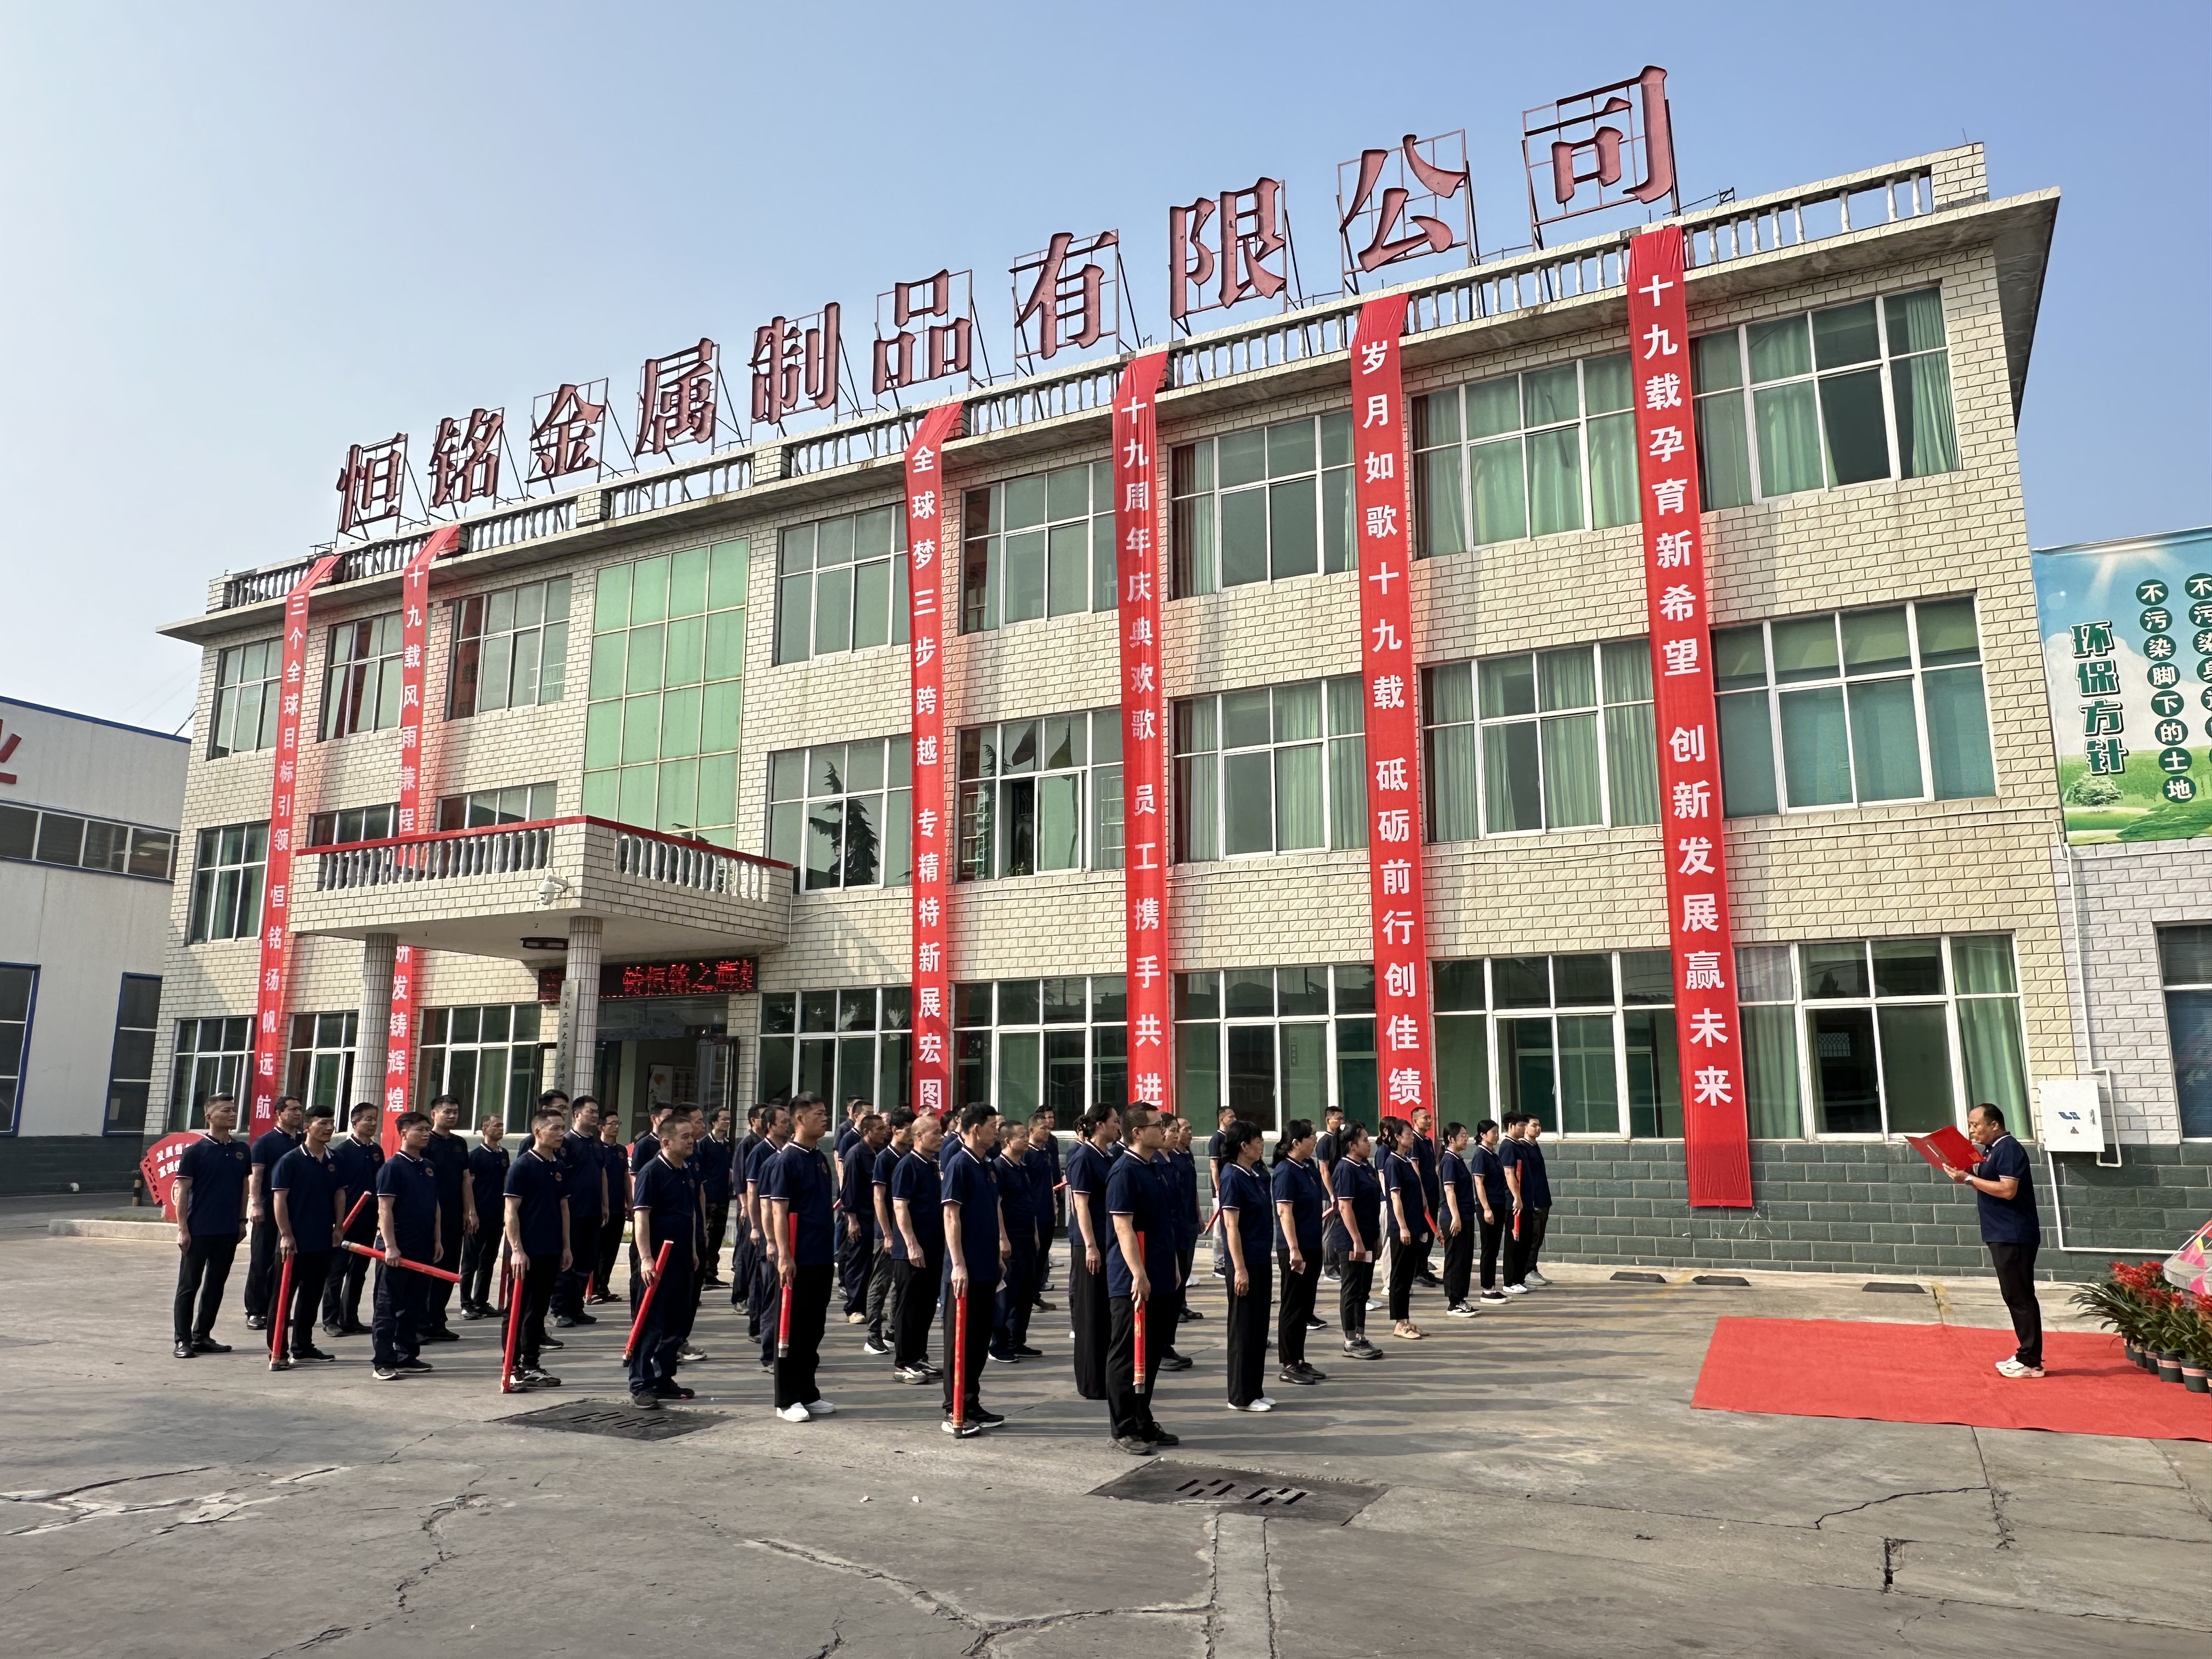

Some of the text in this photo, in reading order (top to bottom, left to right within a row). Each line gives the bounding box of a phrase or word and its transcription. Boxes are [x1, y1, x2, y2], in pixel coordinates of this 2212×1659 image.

[336, 65, 1673, 533] 恒铭金属制品有限公司
[256, 595, 305, 1120] 三个全球目标引领 恒铭扬帆远航
[912, 445, 942, 1109] 全球梦三步跨越 专精特新展宏图
[1121, 396, 1163, 1106] 十九周年庆典欢歌 员工携手共进
[1361, 340, 1423, 1105] 岁月如歌十九载 砥砺前行创佳绩
[1638, 274, 1733, 1107] 十九载孕育新希望 创新发展赢未来
[2070, 620, 2129, 776] 环保方针
[2141, 584, 2192, 800] 不污染脚下的土地
